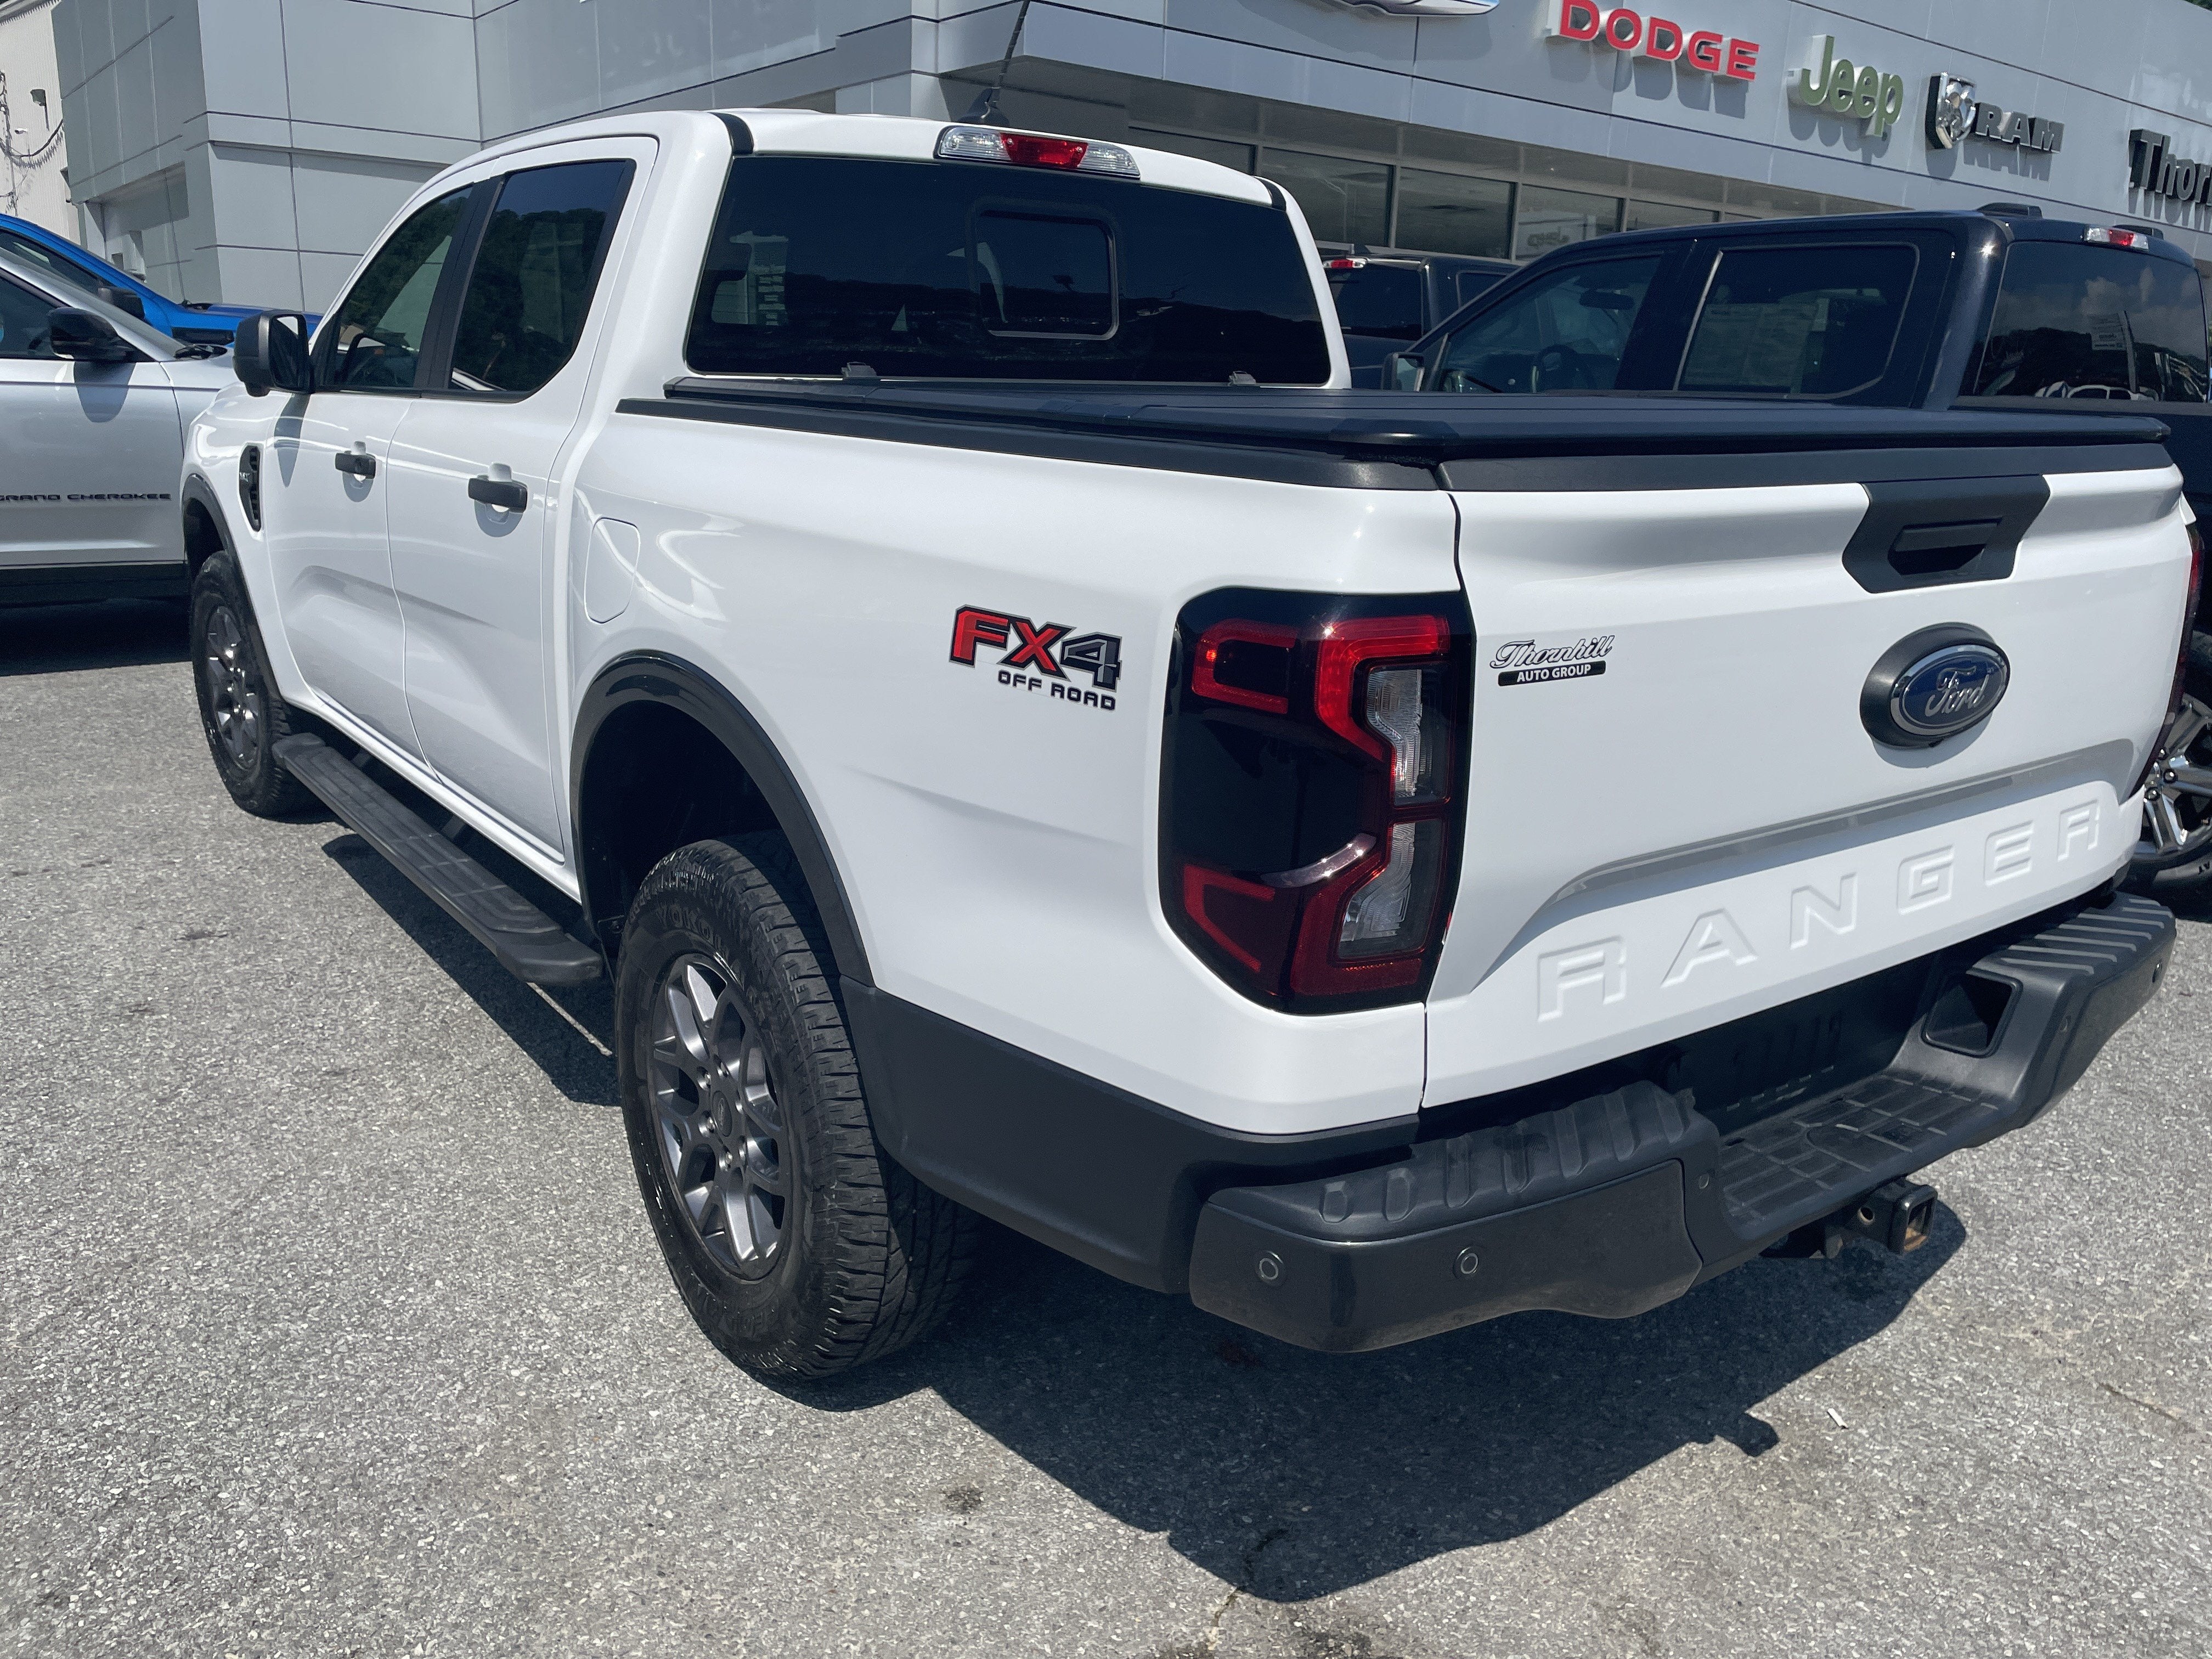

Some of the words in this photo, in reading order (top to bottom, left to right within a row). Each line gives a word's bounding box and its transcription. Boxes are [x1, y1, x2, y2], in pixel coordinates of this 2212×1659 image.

[1557, 0, 1760, 81] DODGE
[1797, 35, 1904, 137] Jeep
[1974, 101, 2064, 154] RAM
[2130, 128, 2212, 207] Thor
[67, 493, 171, 501] CHEROKEE
[949, 604, 1122, 692] FX4
[1489, 635, 1615, 669] Thornhill
[1516, 669, 1550, 683] AUTO
[1551, 664, 1592, 679] GROUP
[998, 669, 1042, 692] OFF
[1051, 682, 1116, 712] ROAD
[1924, 665, 1990, 718] Ford
[1537, 799, 2100, 1023] RANGER
